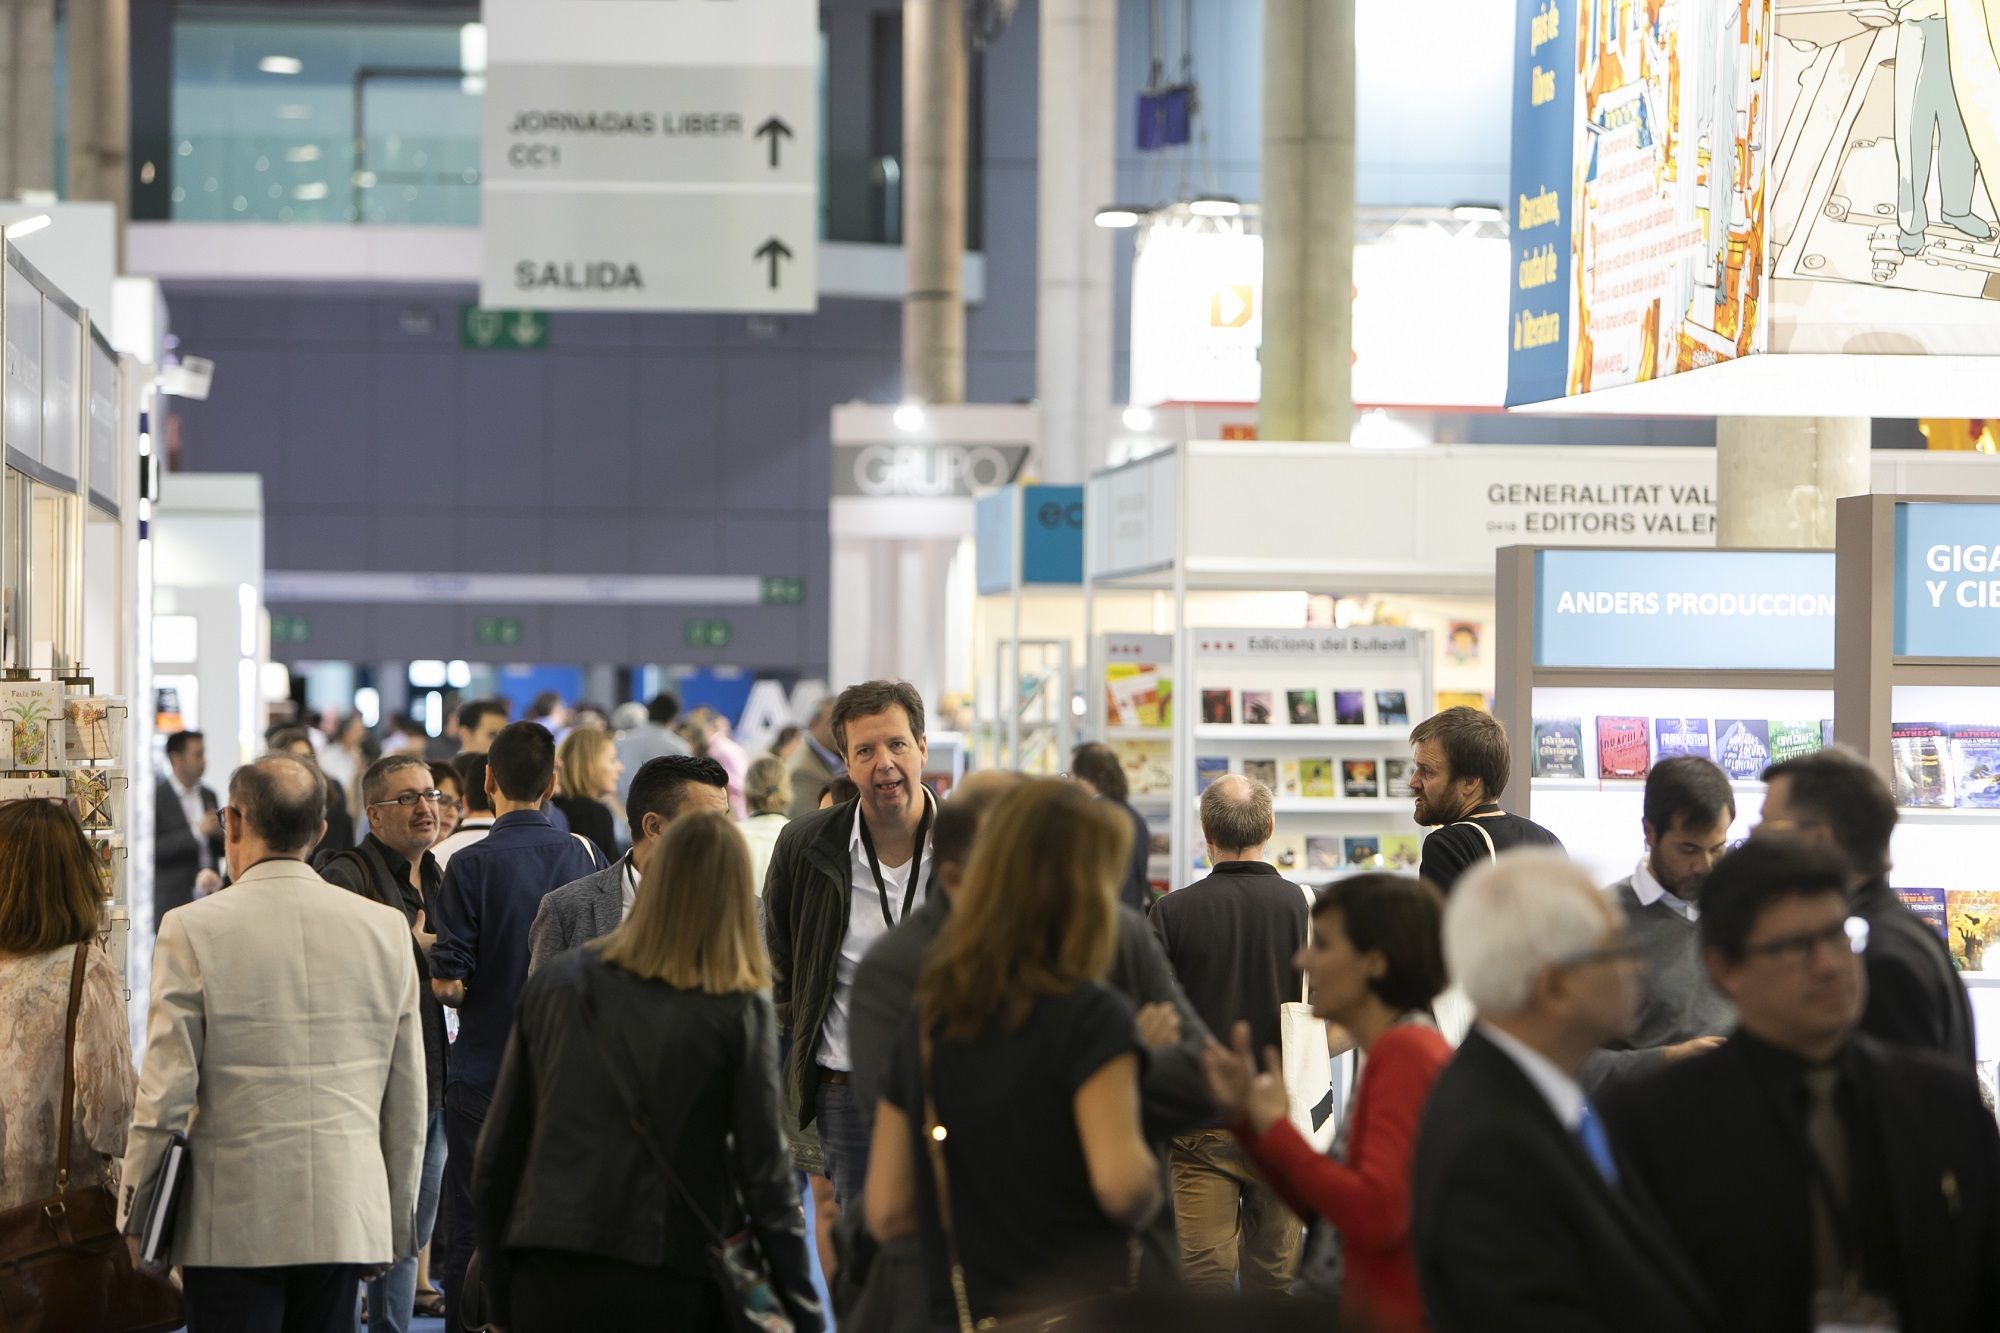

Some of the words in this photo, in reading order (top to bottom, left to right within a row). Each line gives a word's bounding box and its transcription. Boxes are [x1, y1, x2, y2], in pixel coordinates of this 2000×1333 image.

[508, 111, 656, 135] JORNADAS
[662, 111, 744, 135] LIBER
[508, 144, 561, 168] CC1
[513, 260, 644, 291] SALIDA
[853, 446, 1010, 496] GRUPO
[1488, 483, 1663, 505] GENERALITAT
[1670, 484, 1716, 505] VAL
[1525, 512, 1635, 533] EDITORS
[1557, 591, 1660, 615] ANDERS
[1666, 592, 1834, 617] PRODUCCION
[1925, 580, 1948, 608] Y
[1321, 636, 1347, 651] del
